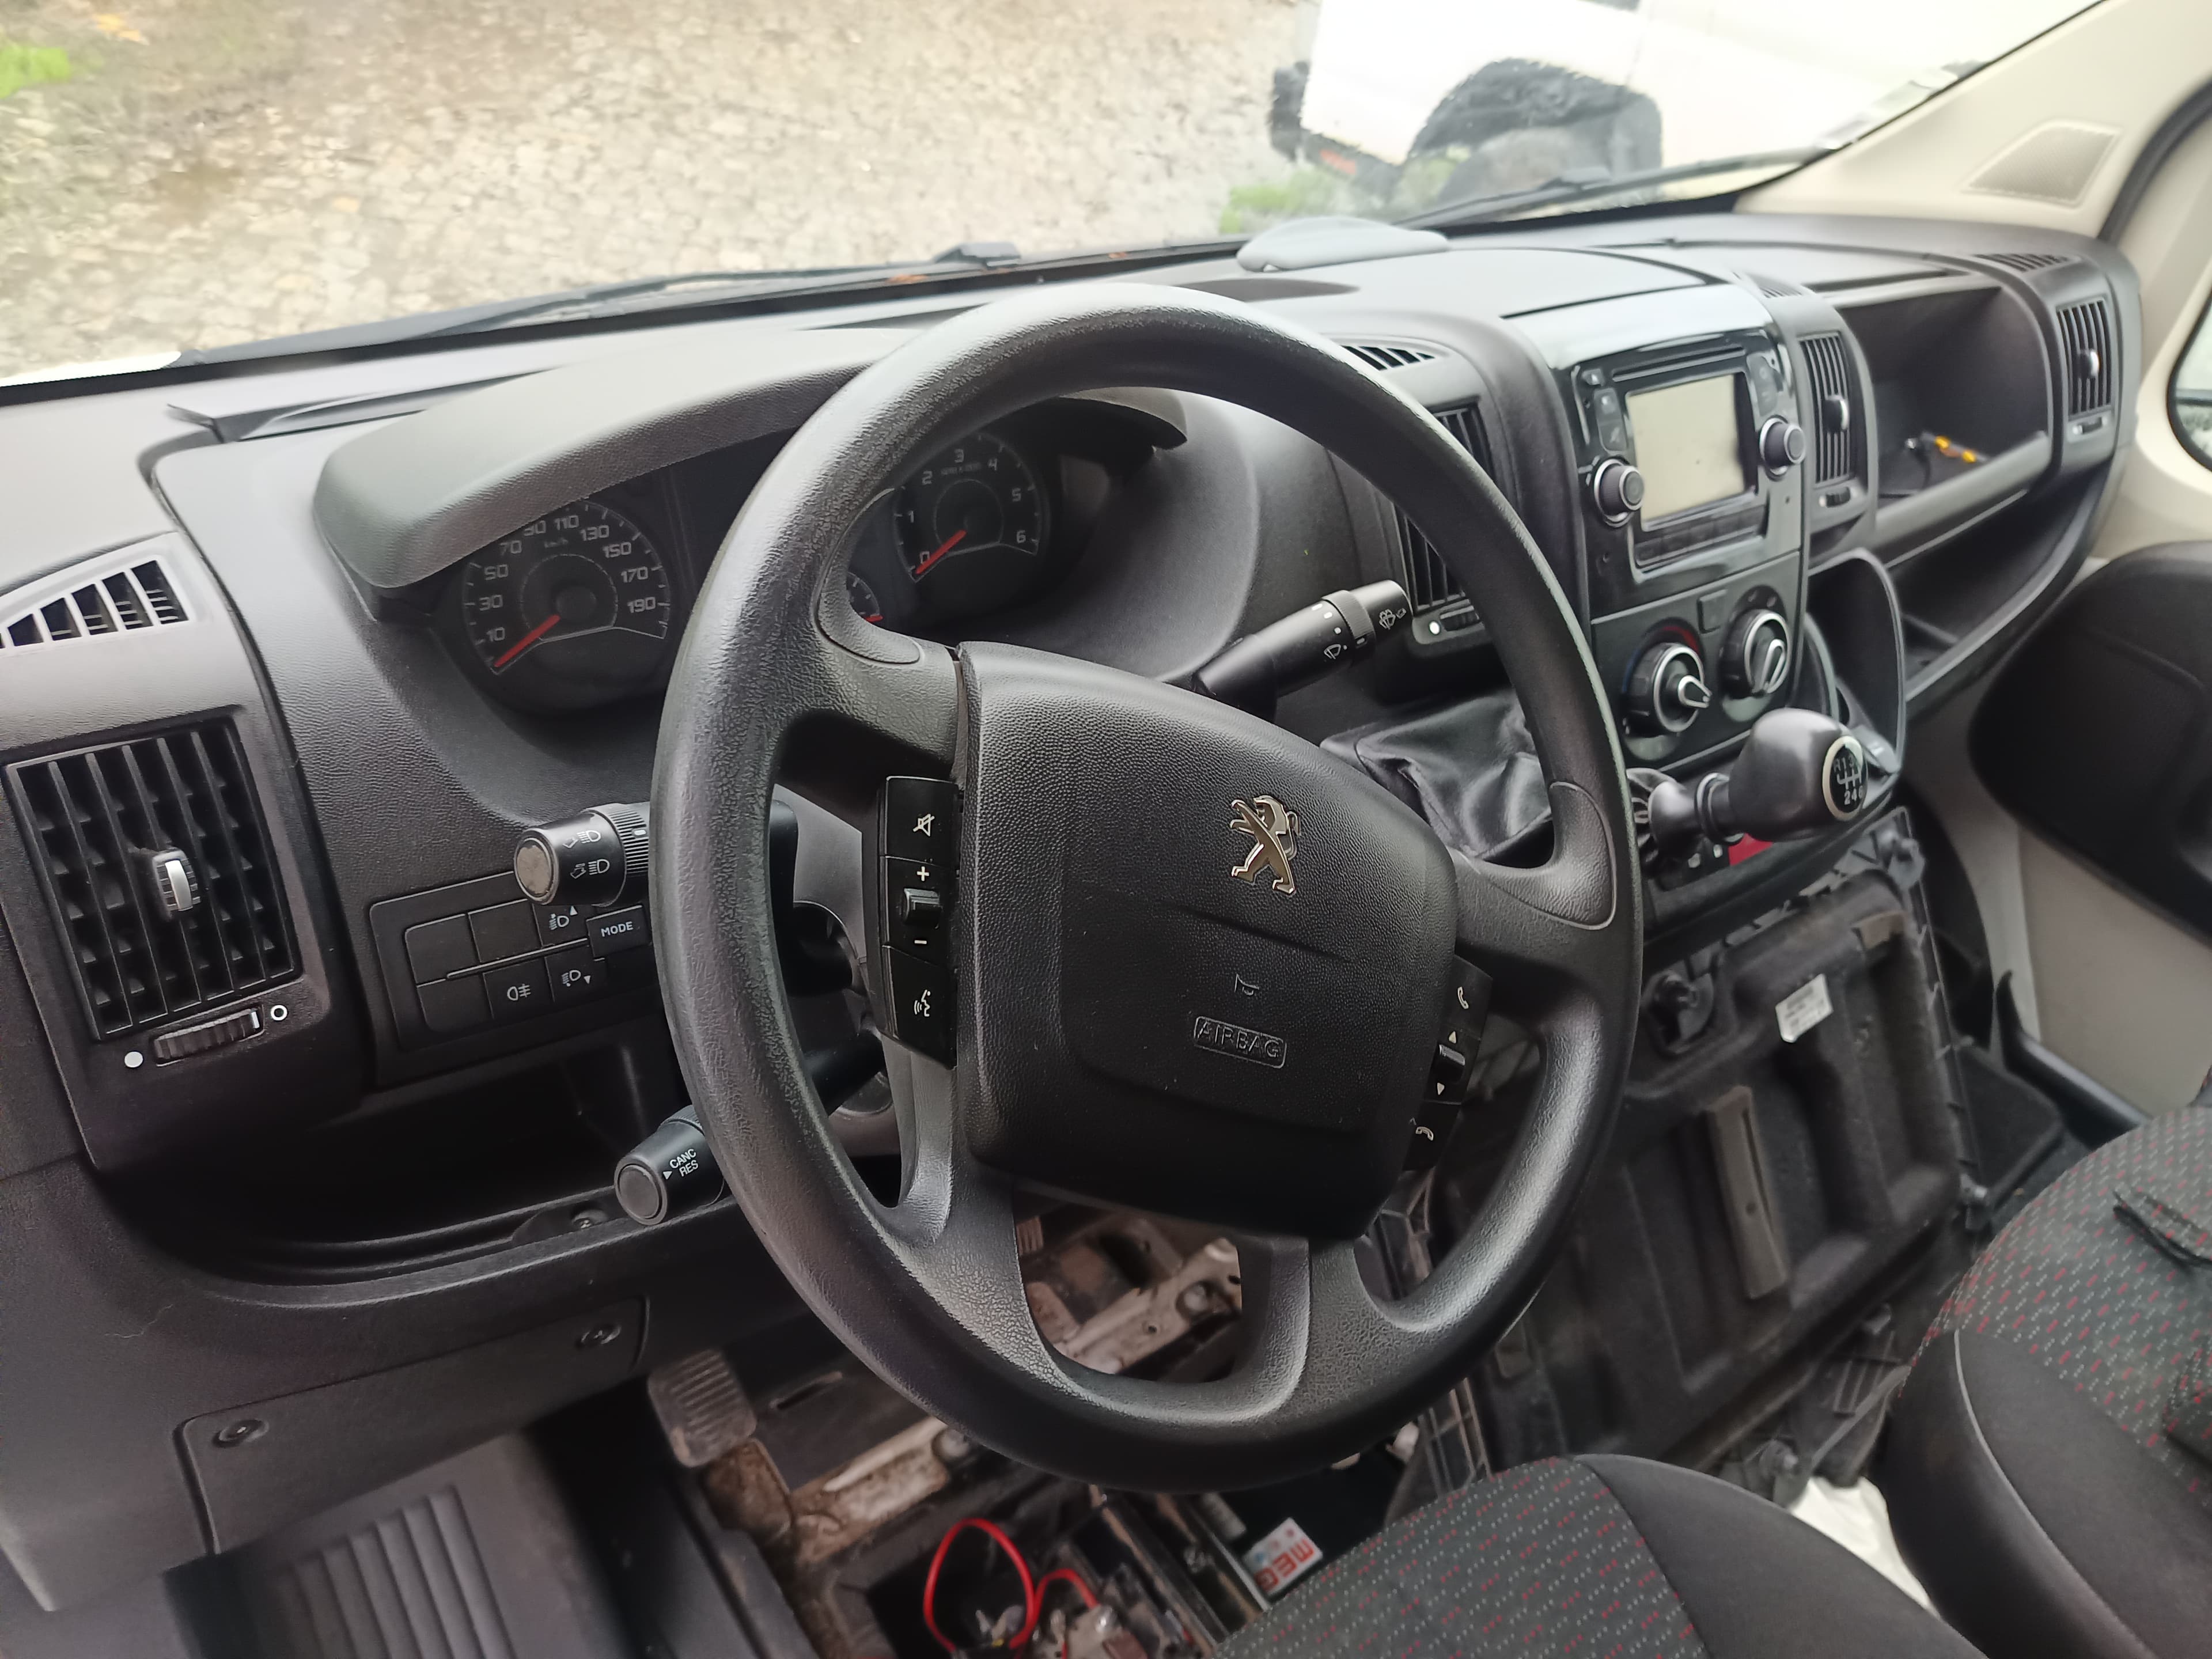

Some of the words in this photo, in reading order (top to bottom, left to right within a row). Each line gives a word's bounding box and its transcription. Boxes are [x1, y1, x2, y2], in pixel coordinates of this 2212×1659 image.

[955, 449, 964, 463] 3
[988, 459, 998, 471] 4
[922, 471, 932, 484] 2
[1012, 488, 1021, 502] 5
[554, 515, 579, 531] 110
[908, 511, 915, 523] 1
[580, 525, 609, 541] 130
[1016, 530, 1026, 543] 6
[499, 540, 522, 556] 70
[602, 542, 632, 558] 150
[919, 551, 930, 564] 0
[484, 564, 509, 580] 50
[621, 567, 649, 584] 170
[479, 594, 503, 611] 30
[627, 597, 656, 613] 190
[486, 627, 505, 642] 10
[601, 921, 634, 937] MODE
[1197, 1021, 1279, 1058] AIRBAG
[669, 1149, 696, 1169] CANC
[679, 1160, 699, 1177] RES
